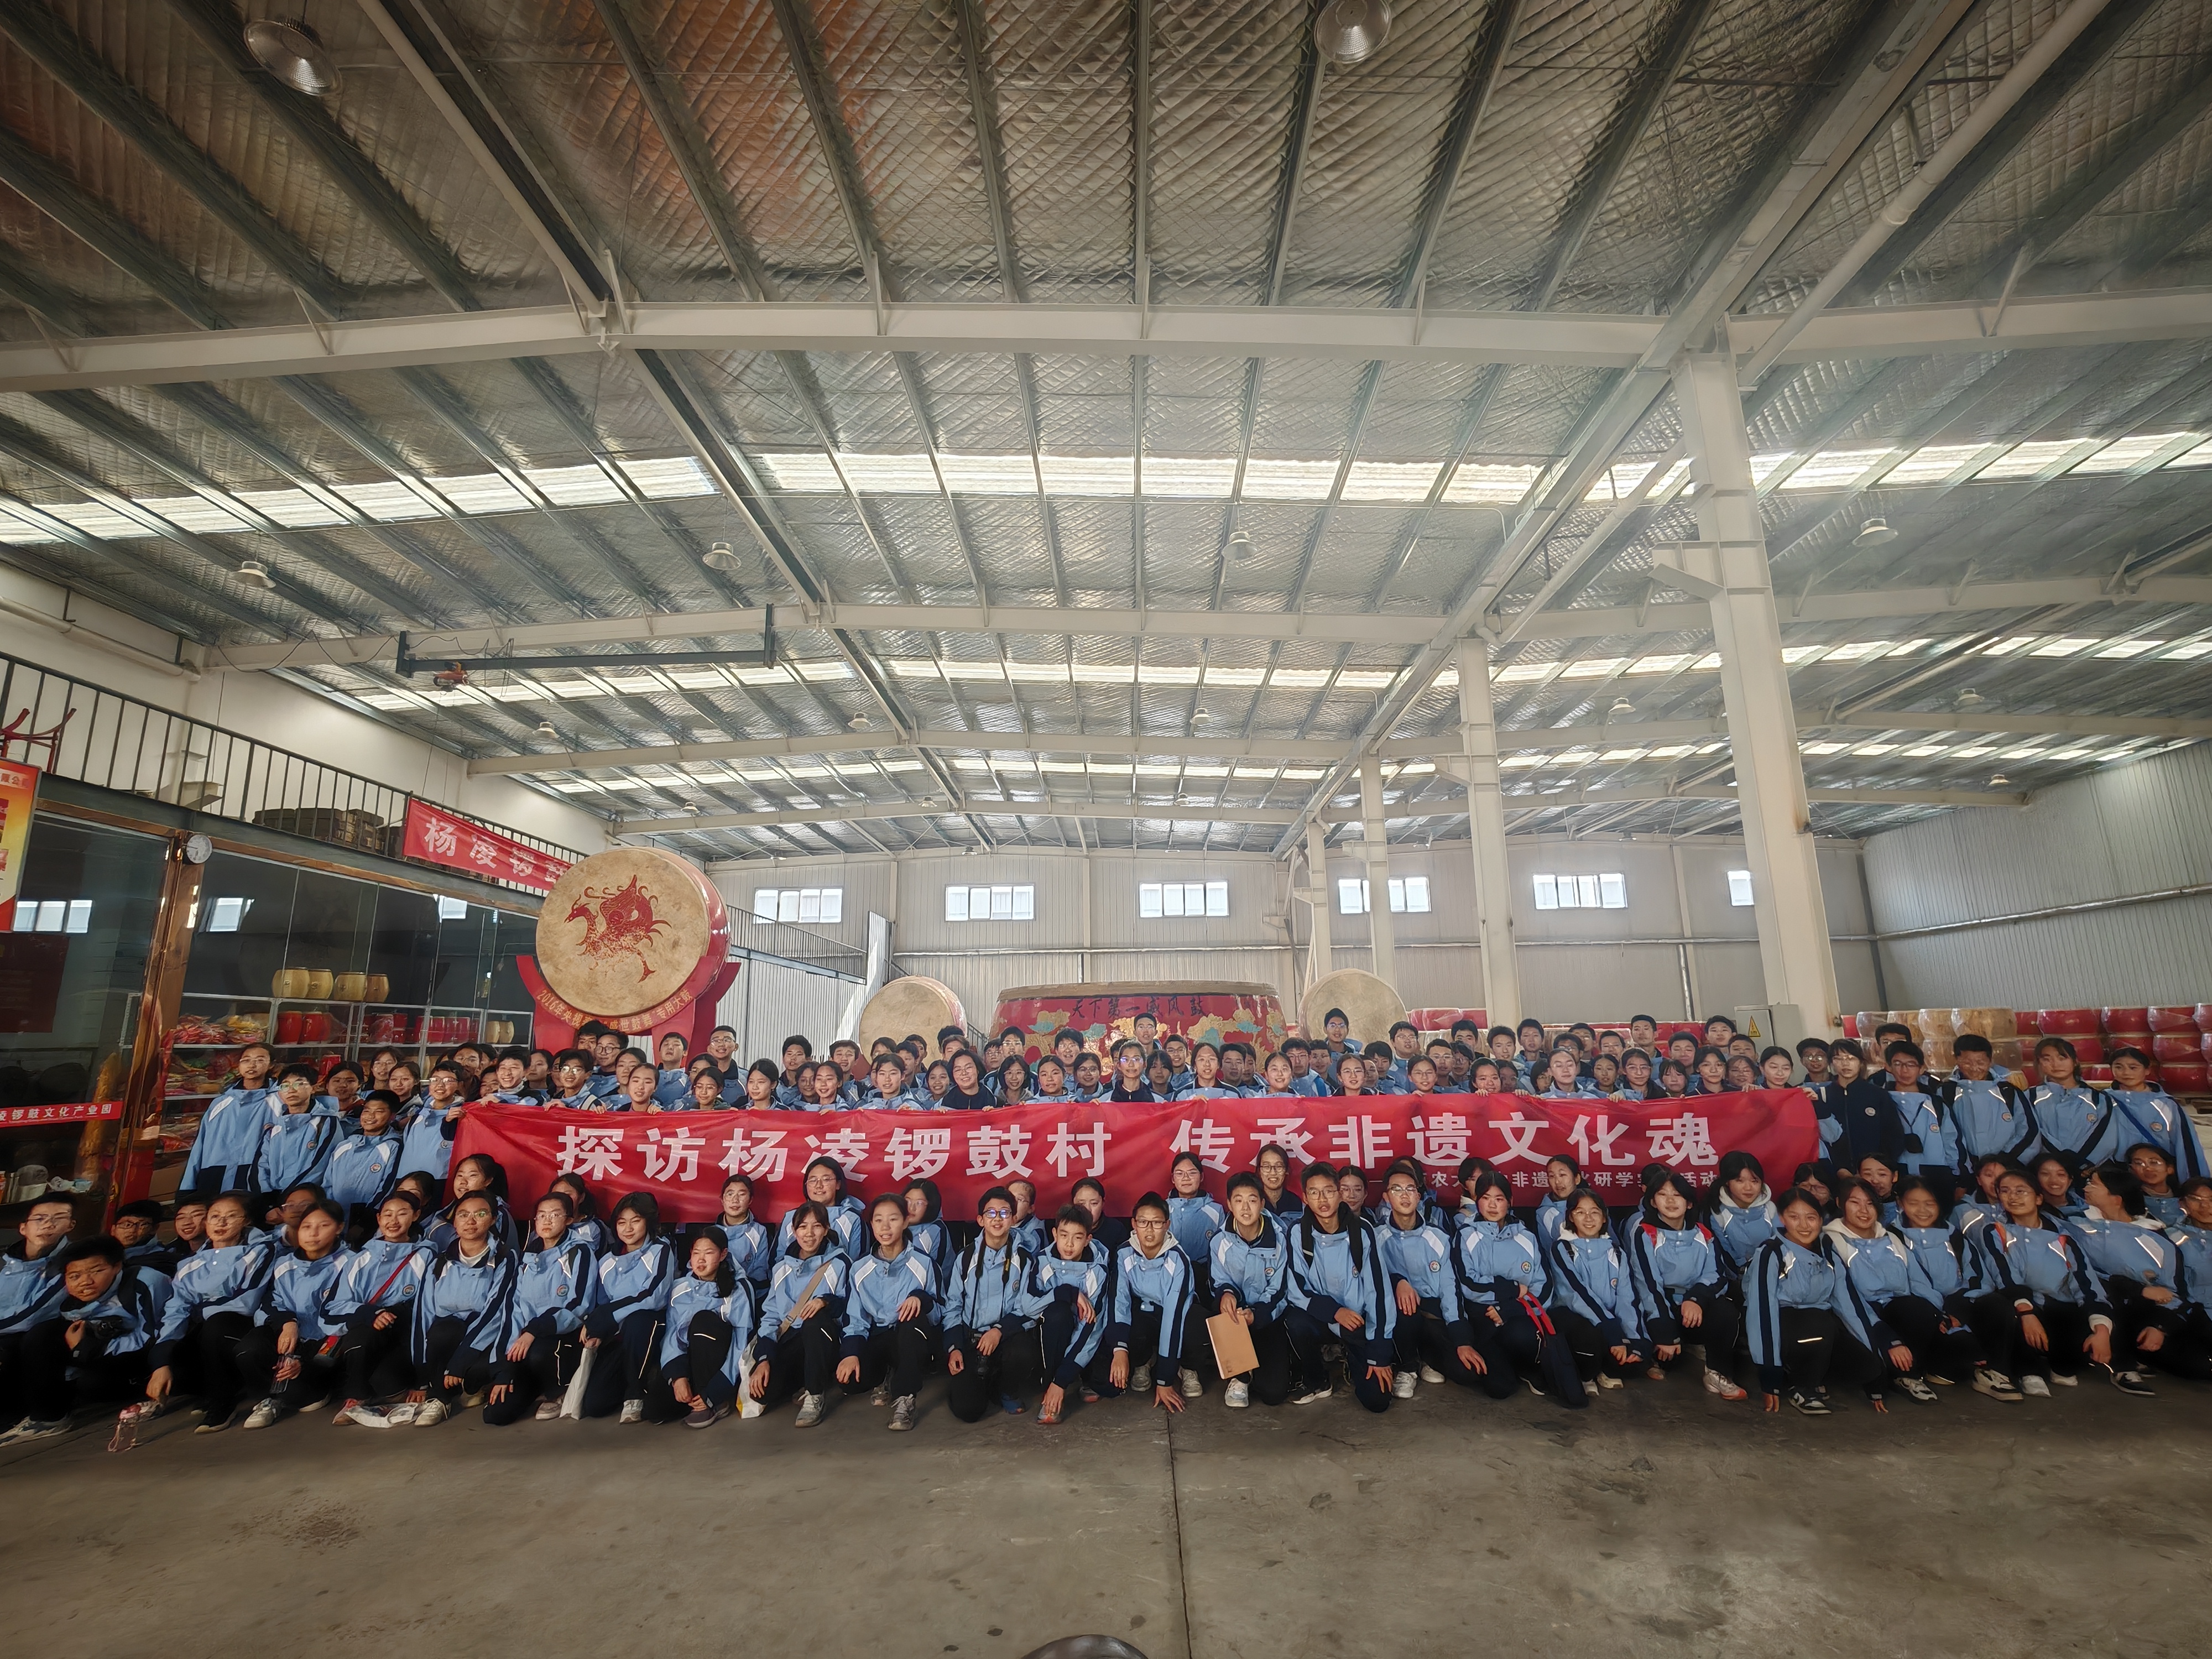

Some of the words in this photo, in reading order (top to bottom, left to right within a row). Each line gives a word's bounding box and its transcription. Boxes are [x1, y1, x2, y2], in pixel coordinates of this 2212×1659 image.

[556, 1122, 1112, 1182] 探访杨凌锣鼓村
[1170, 1112, 1719, 1173] 传承非遗文化魂
